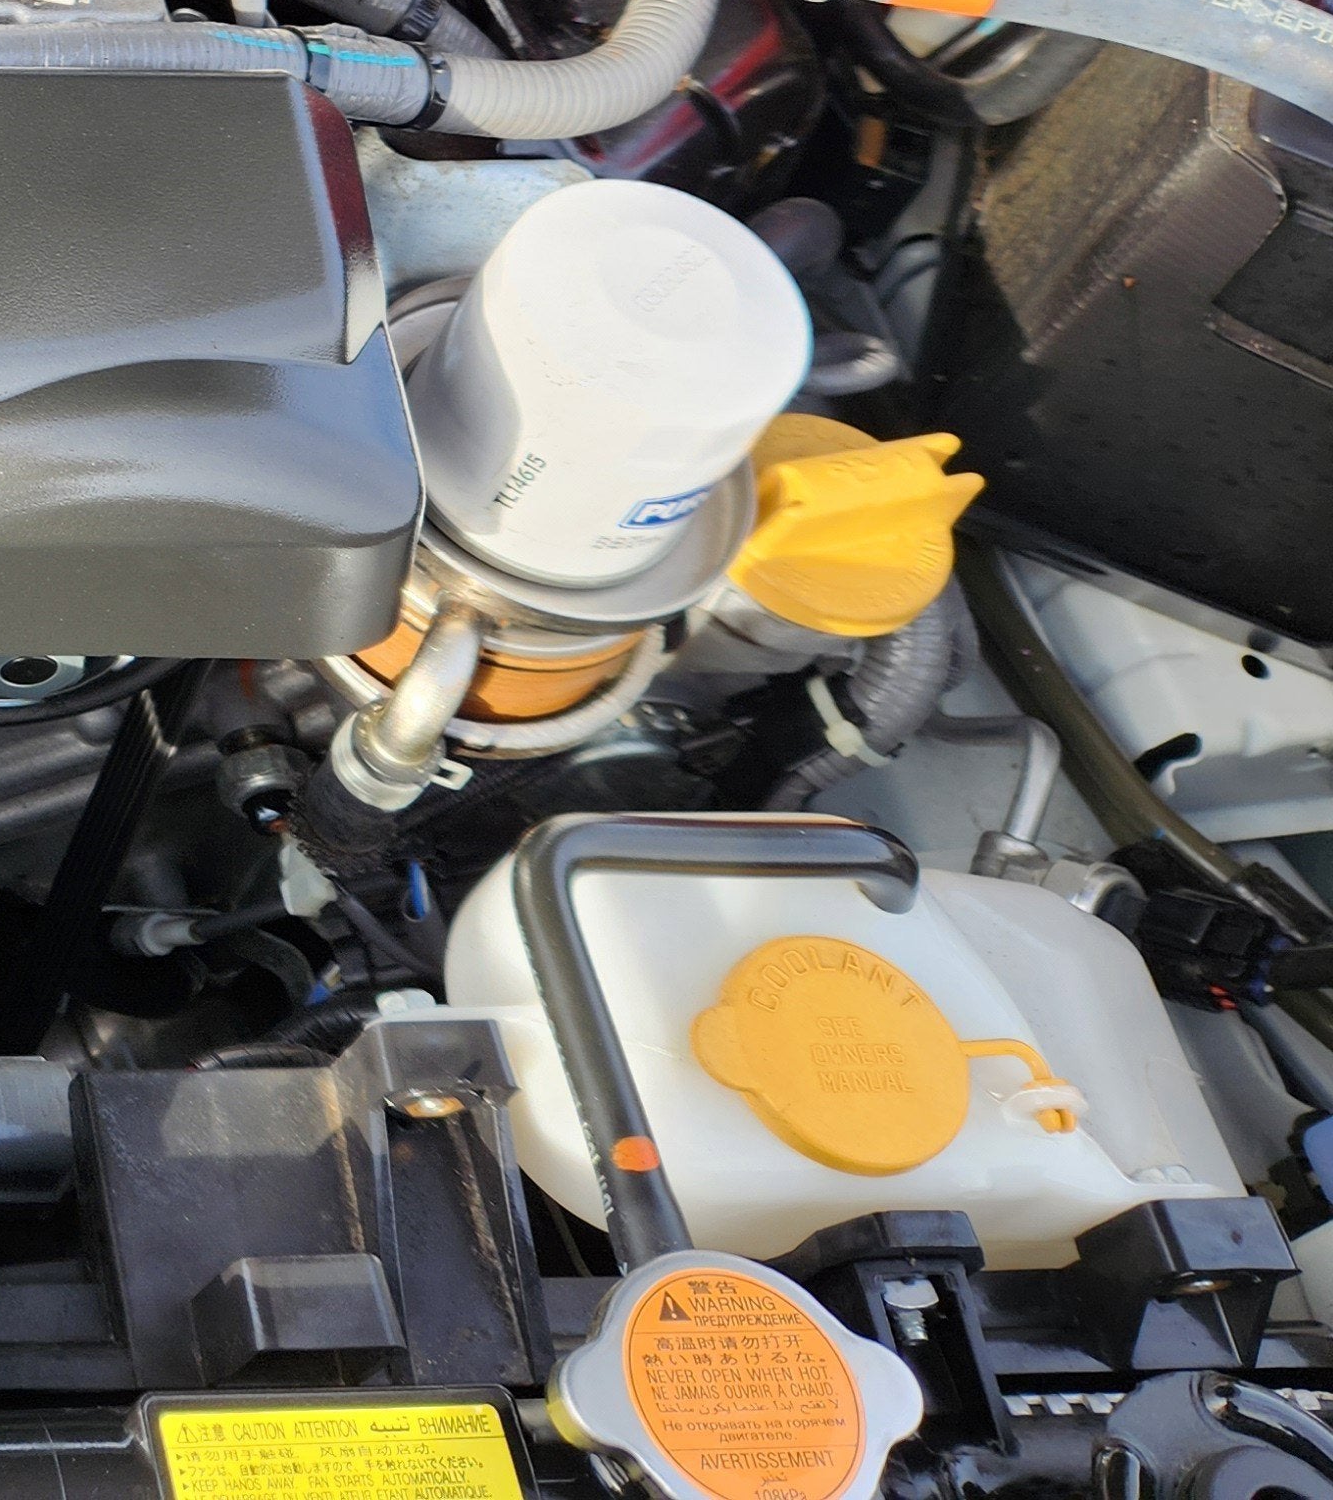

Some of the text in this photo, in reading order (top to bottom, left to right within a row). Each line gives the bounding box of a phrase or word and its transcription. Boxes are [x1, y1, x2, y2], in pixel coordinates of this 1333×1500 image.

[493, 453, 547, 510] TL14615
[748, 945, 923, 1013] COOLANT
[816, 1016, 864, 1038] SEE
[818, 1070, 916, 1094] MANUAL
[687, 1295, 777, 1313] WARNING
[693, 1313, 803, 1329] ПРЕДУПРЕЖДЕНИЕ
[656, 1333, 803, 1351] 高温时请勿打开
[645, 1365, 833, 1385] NEVER OPEN WHEN HOT.
[650, 1385, 669, 1401] NE
[673, 1385, 720, 1401] JAMAIS
[725, 1383, 772, 1399] OUVRIR
[791, 1381, 838, 1397] CHAUD.
[231, 1420, 286, 1441] CAUTION
[294, 1418, 358, 1439] ATTENTION
[418, 1413, 492, 1435] ВНИМАНИЕ
[662, 1419, 683, 1432] Не
[687, 1418, 761, 1432] открывать
[765, 1419, 783, 1430] на
[700, 1450, 835, 1470] AVERTISSEMENT
[191, 1479, 217, 1492] KEEP
[308, 1474, 331, 1489] FAN
[335, 1472, 374, 1488] STARTS
